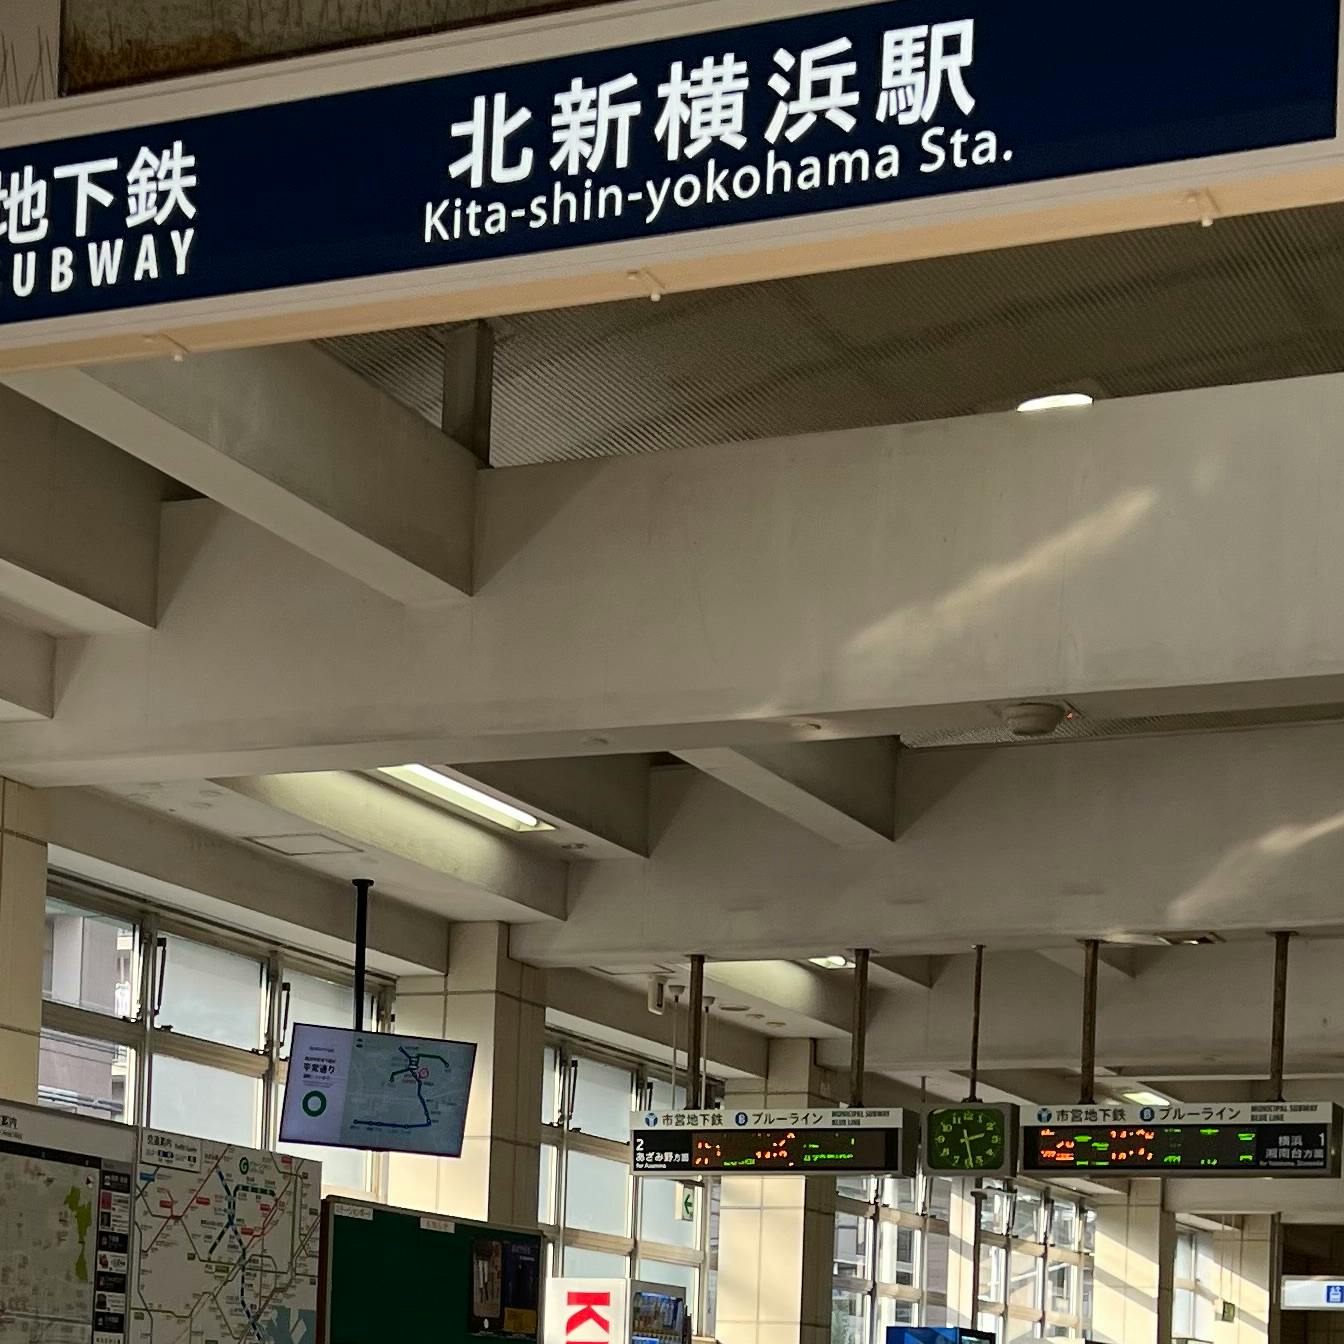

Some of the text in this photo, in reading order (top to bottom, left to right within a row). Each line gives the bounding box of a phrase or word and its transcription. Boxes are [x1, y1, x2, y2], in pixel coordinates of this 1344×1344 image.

[447, 18, 976, 188] 北新横浜駅
[423, 125, 1014, 244] Kita-shin-yokohama Sta.
[662, 1113, 723, 1126] 市営地下鉄
[752, 1112, 823, 1126] ブルーライン
[1056, 1108, 1127, 1122] 市営地下鉄
[1159, 1107, 1241, 1120] ブルーライン
[636, 1138, 644, 1151] 2
[1319, 1132, 1325, 1147] 1
